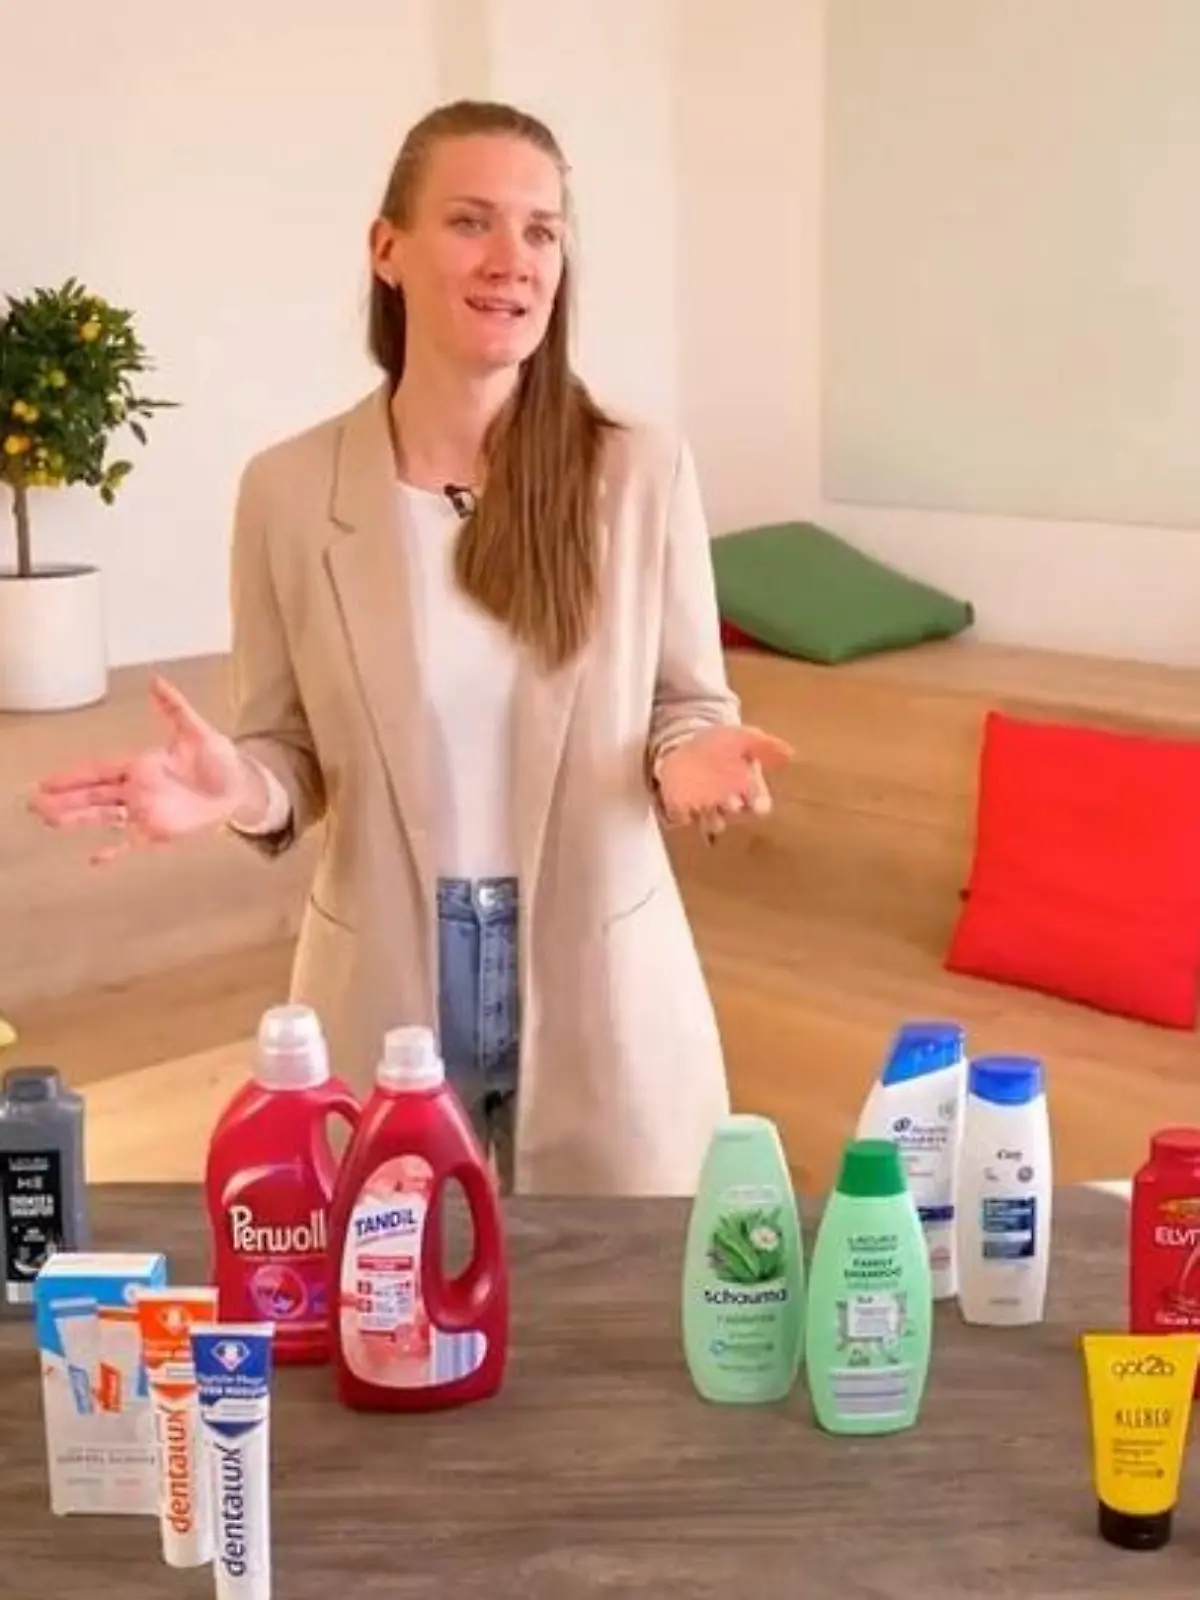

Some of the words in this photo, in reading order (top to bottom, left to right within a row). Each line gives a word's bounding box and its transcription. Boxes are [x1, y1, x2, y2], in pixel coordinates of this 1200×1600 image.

[229, 1204, 328, 1252] Perwoll
[355, 1208, 417, 1236] TANDIL
[159, 1405, 193, 1534] dentalux
[213, 1442, 247, 1578] dentalux
